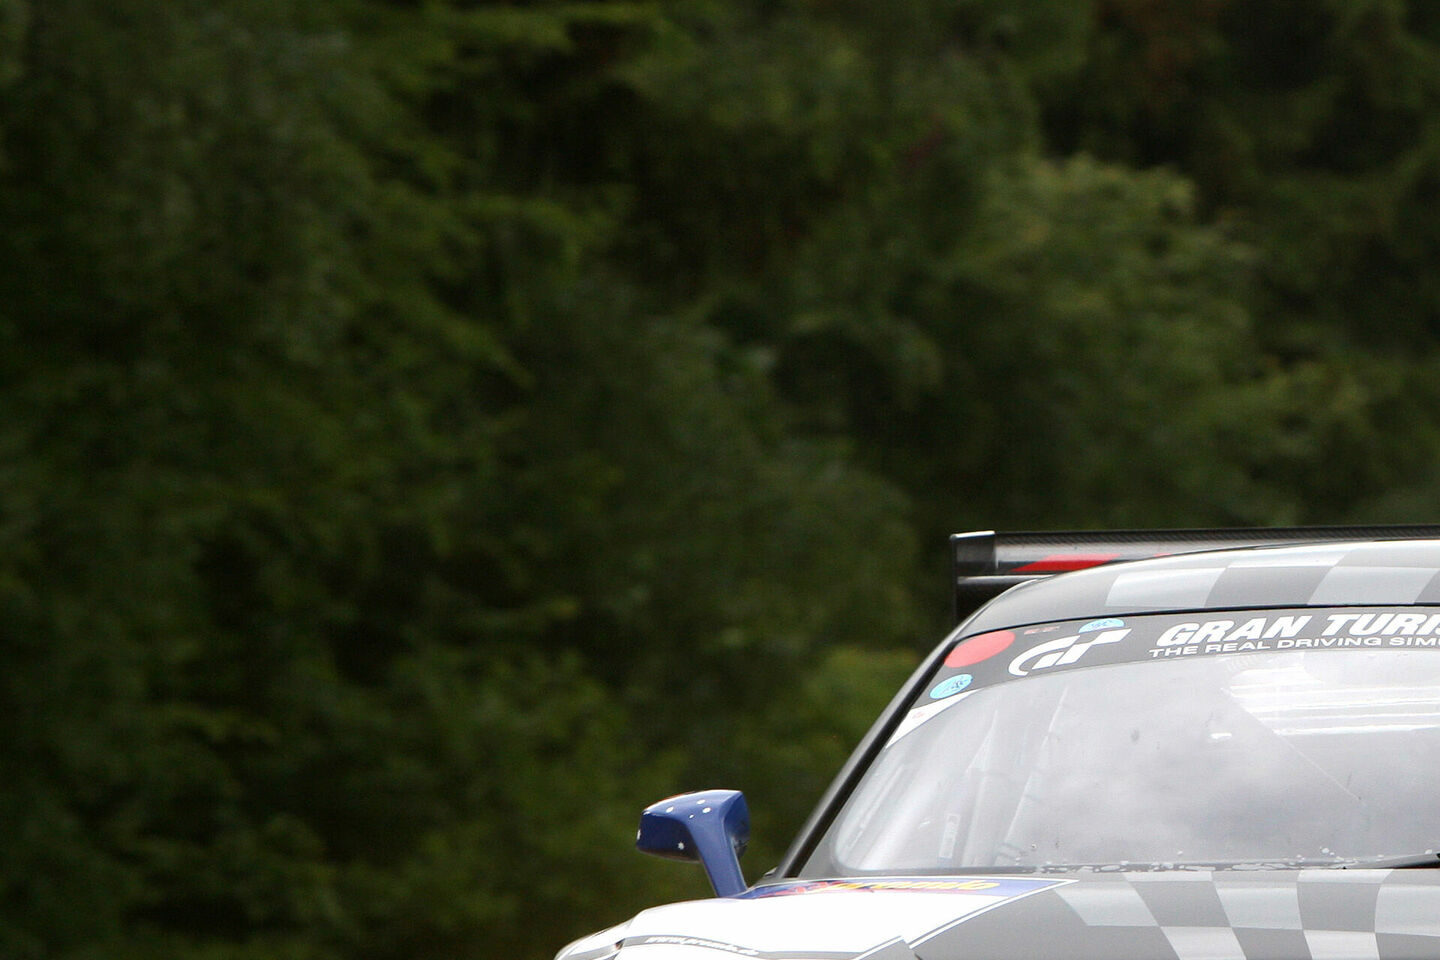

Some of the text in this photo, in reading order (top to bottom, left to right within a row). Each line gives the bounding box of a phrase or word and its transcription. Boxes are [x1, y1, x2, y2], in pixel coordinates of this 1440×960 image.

[1156, 615, 1312, 647] GRAN
[1149, 645, 1200, 658] THE
[1204, 640, 1270, 654] REAL
[1277, 636, 1384, 649] DRIVING
